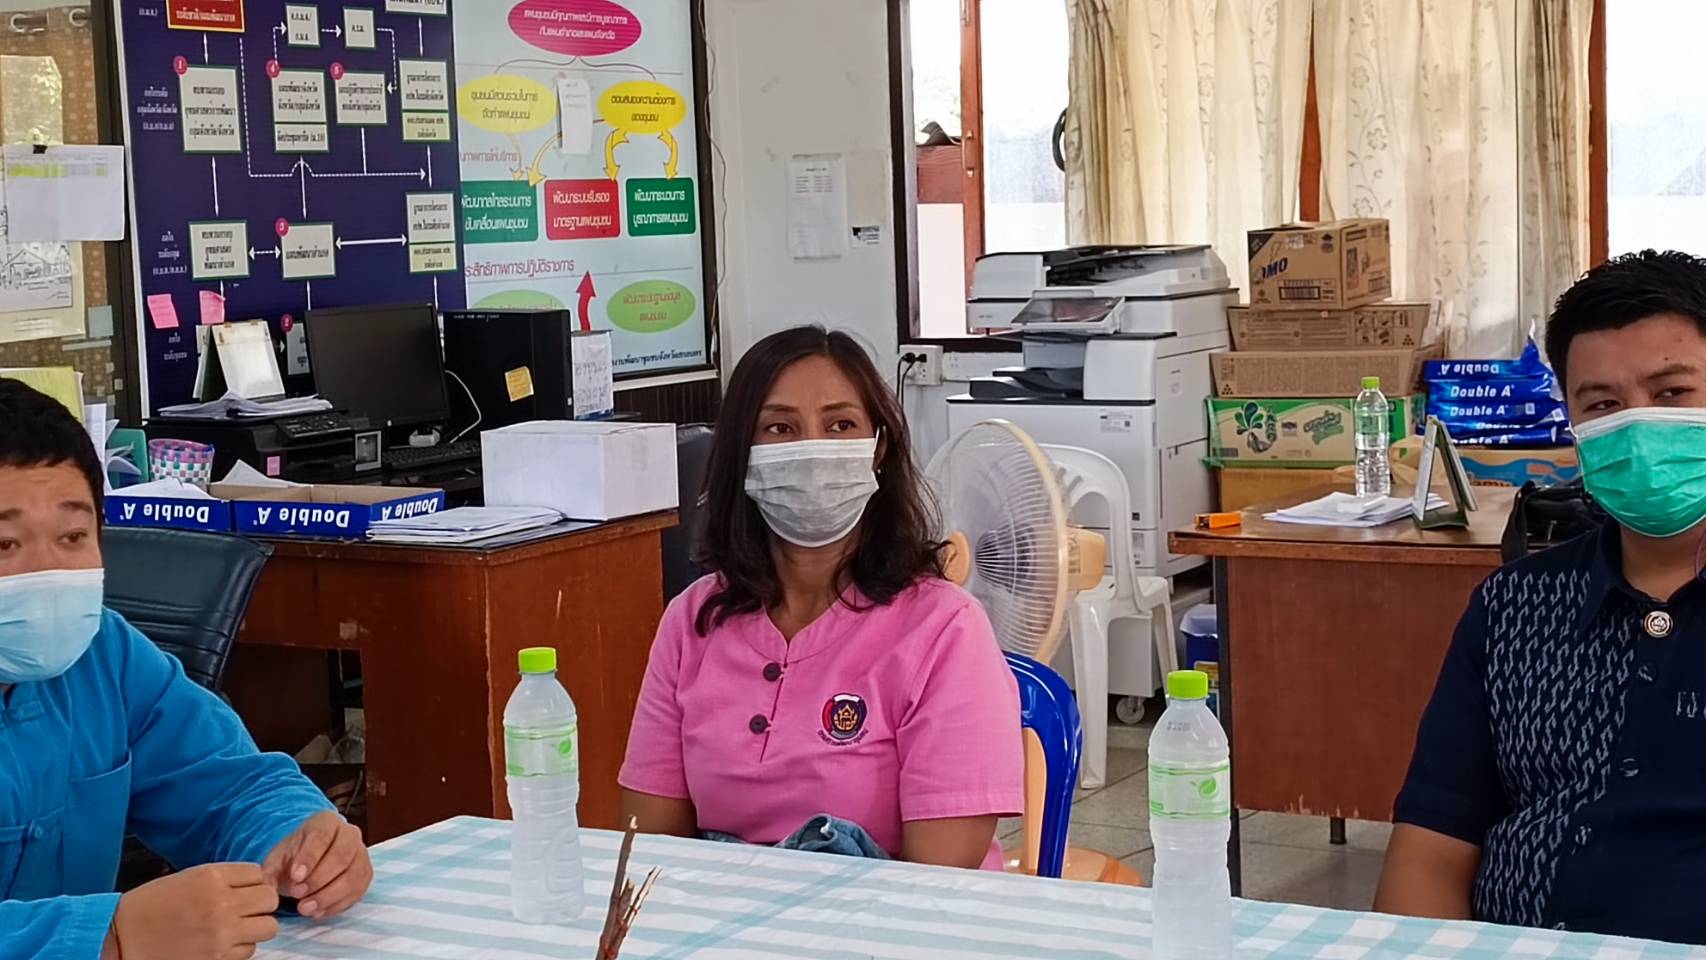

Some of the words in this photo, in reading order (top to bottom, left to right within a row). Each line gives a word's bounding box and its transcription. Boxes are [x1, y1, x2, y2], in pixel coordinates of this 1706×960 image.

[1441, 364, 1450, 375] A
[1453, 363, 1500, 375] Double
[1450, 384, 1497, 397] Double
[1501, 385, 1511, 397] A
[1450, 405, 1493, 417] Double
[1496, 404, 1506, 415] A
[123, 502, 136, 520] A
[143, 503, 210, 523] Double
[257, 506, 272, 525] A
[382, 505, 393, 521] A
[394, 497, 439, 519] Double
[278, 506, 350, 528] Double
